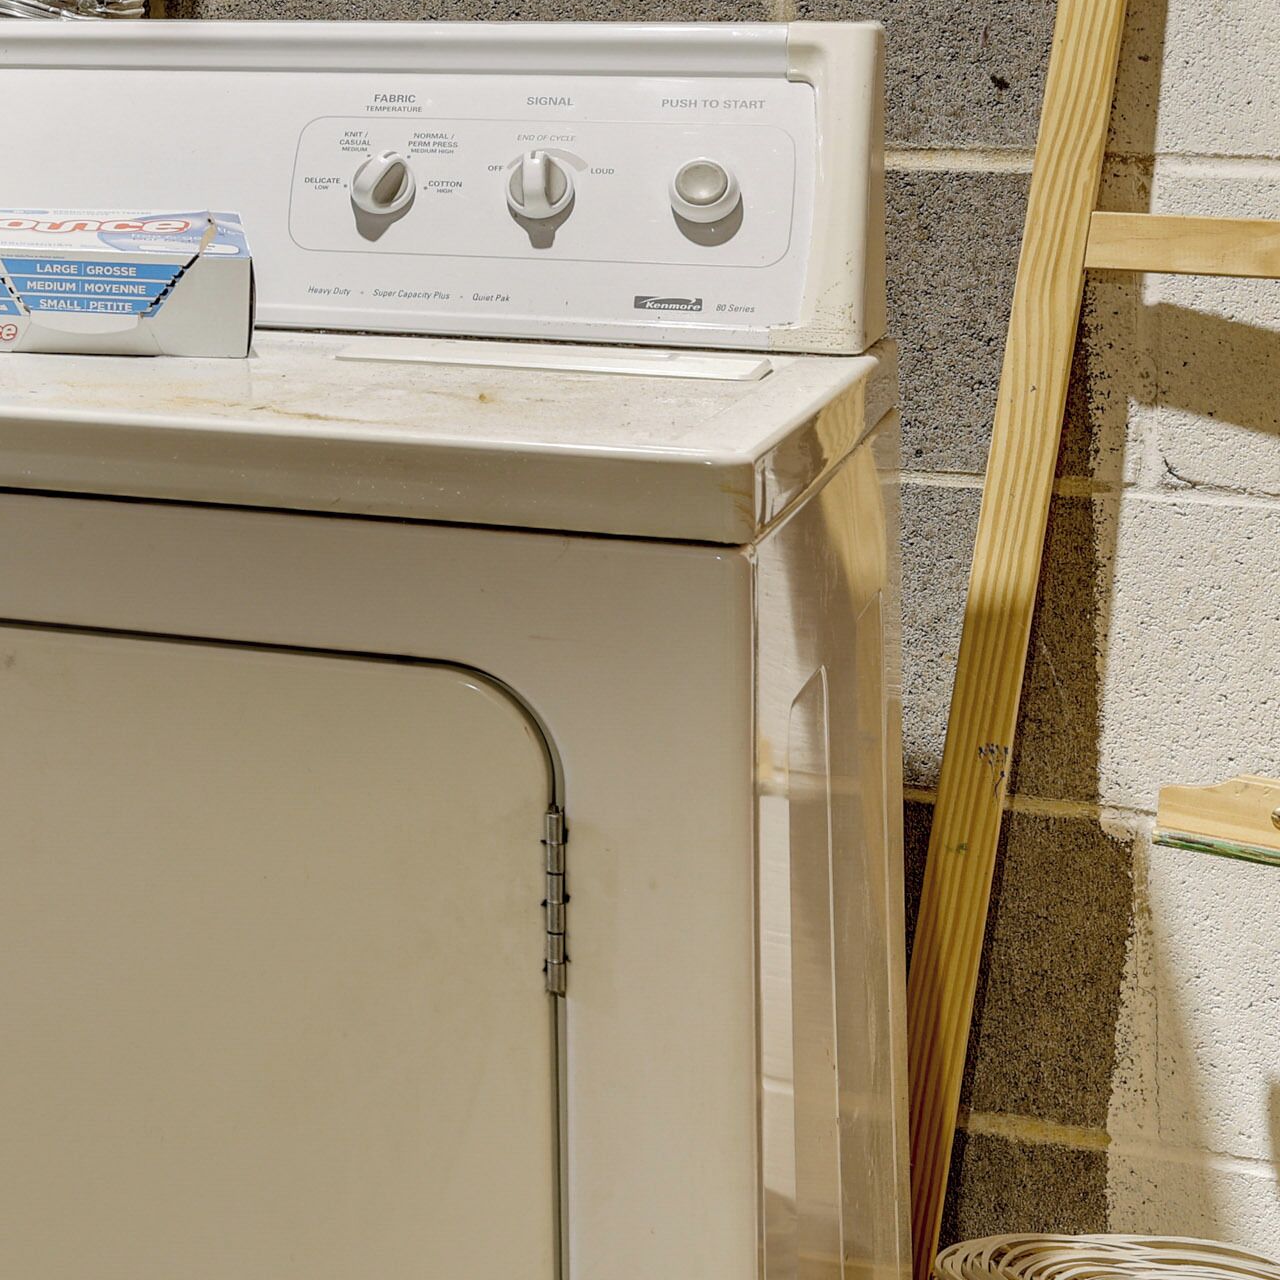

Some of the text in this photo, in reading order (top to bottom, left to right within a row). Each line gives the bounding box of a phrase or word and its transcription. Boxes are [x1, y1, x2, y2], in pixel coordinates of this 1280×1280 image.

[374, 94, 416, 103] FABRIC
[526, 96, 575, 106] SIGNAL
[366, 105, 423, 113] TEMPERATURE
[661, 98, 766, 110] PUSH TO START
[413, 132, 449, 140] NORMAL
[517, 134, 535, 142] END
[537, 134, 549, 142] OF
[408, 140, 431, 148] PERM
[428, 180, 463, 188] COTTON
[36, 265, 137, 276] LARGE GROSSE
[26, 281, 147, 294] MEDIUM MOYENNE
[308, 285, 511, 302] Heavy Duty Super Capacity Plus Quiet Pak
[39, 299, 133, 312] SMALL PETITE
[645, 301, 755, 313] Kenmore 80 Series
